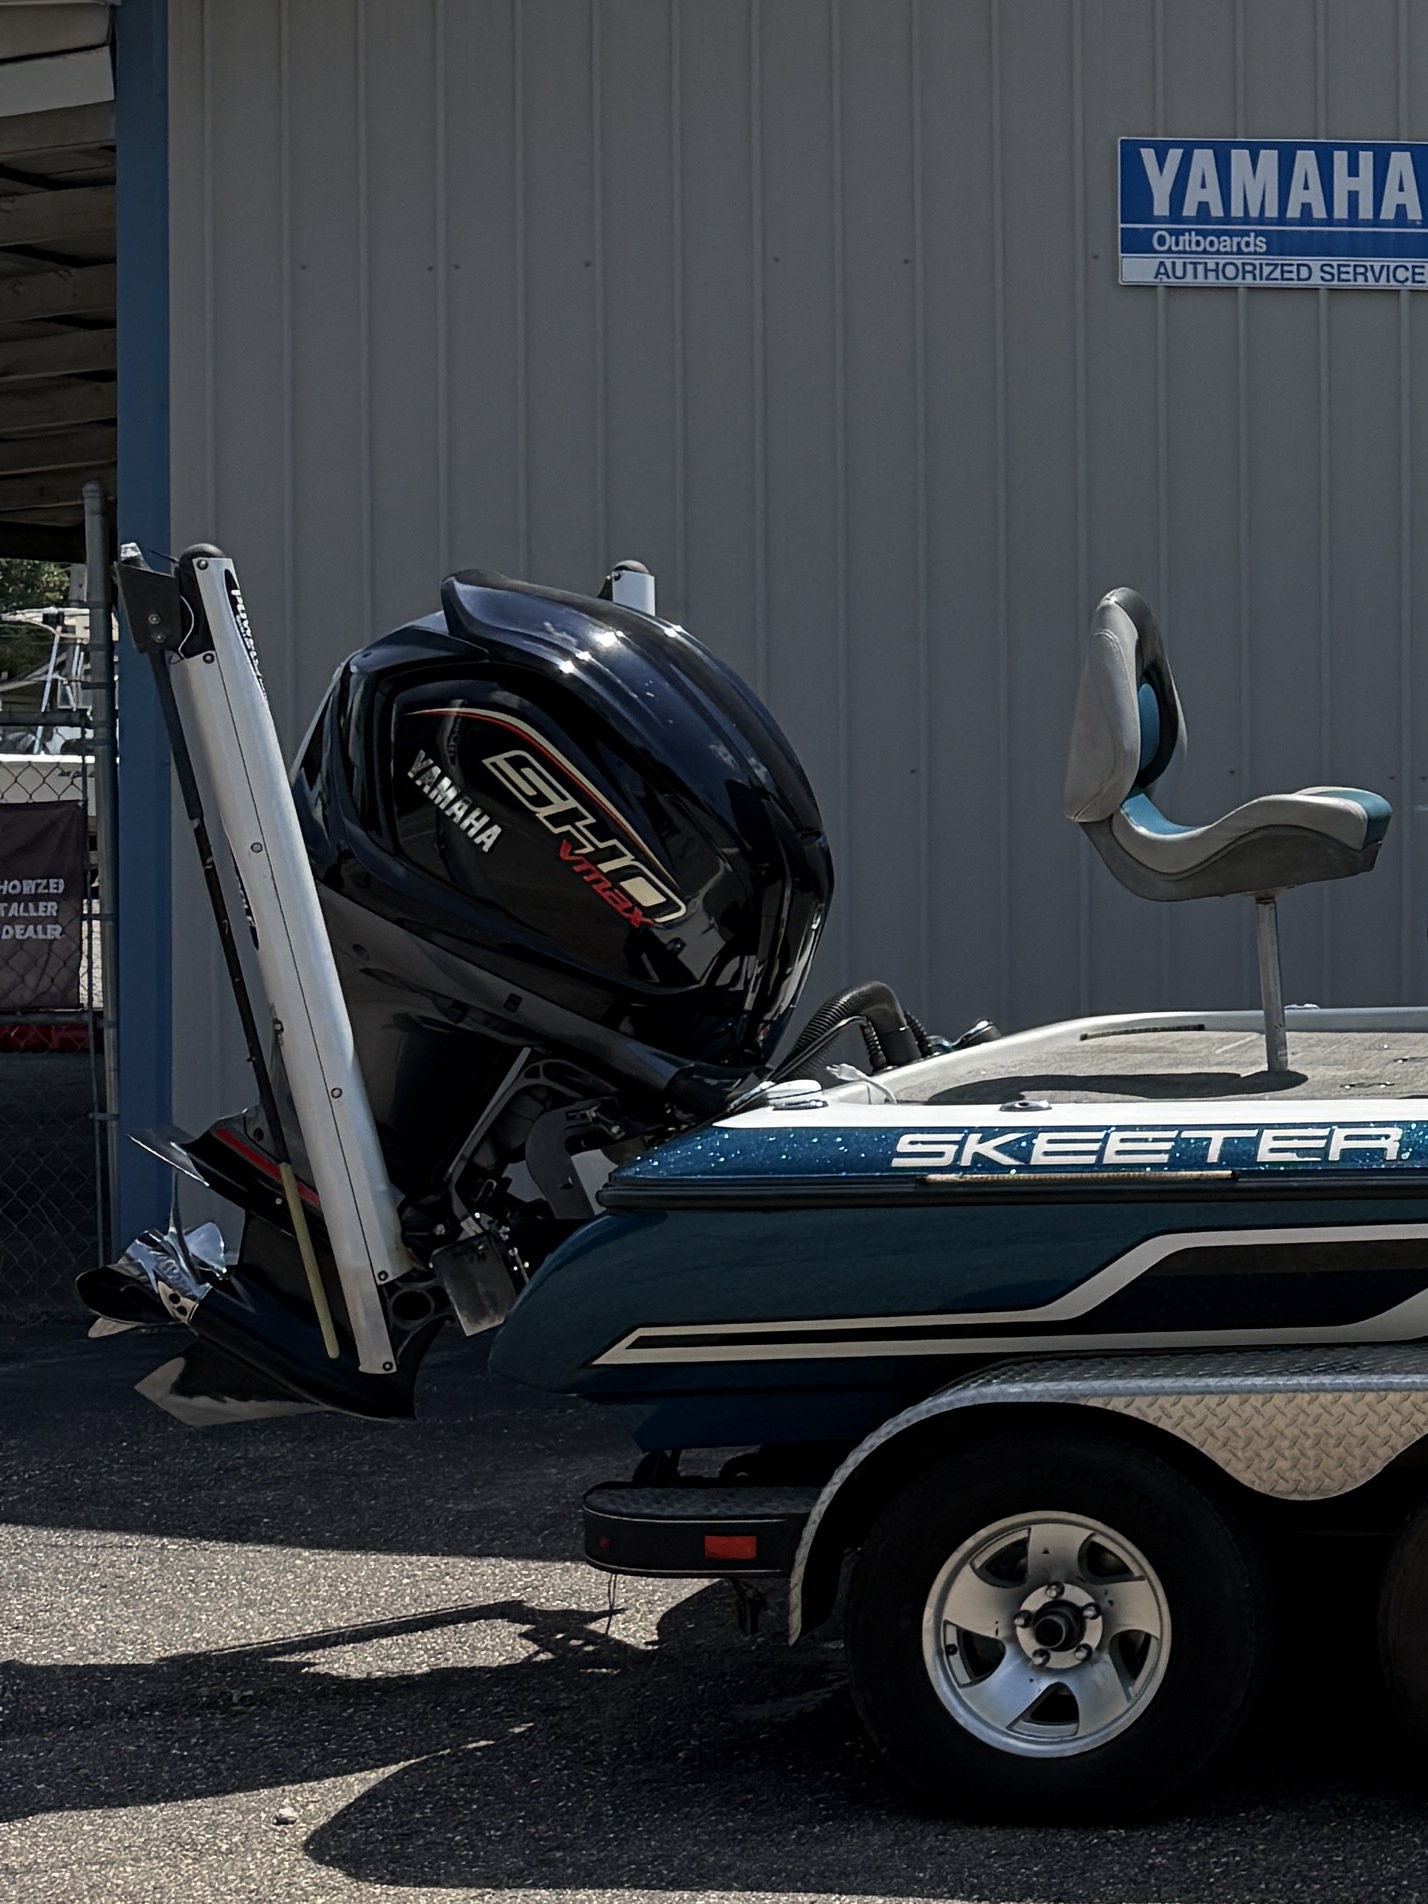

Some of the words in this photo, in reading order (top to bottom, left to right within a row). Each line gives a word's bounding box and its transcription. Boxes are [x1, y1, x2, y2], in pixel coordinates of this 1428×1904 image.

[1139, 147, 1424, 221] YAMAHA
[1151, 230, 1268, 253] Outboards
[1153, 261, 1313, 283] AUTHORIZED
[1319, 264, 1427, 284] SERVICE
[407, 749, 502, 853] YAMAHA
[481, 749, 688, 925] SHO
[891, 1128, 1404, 1167] SKEETER
